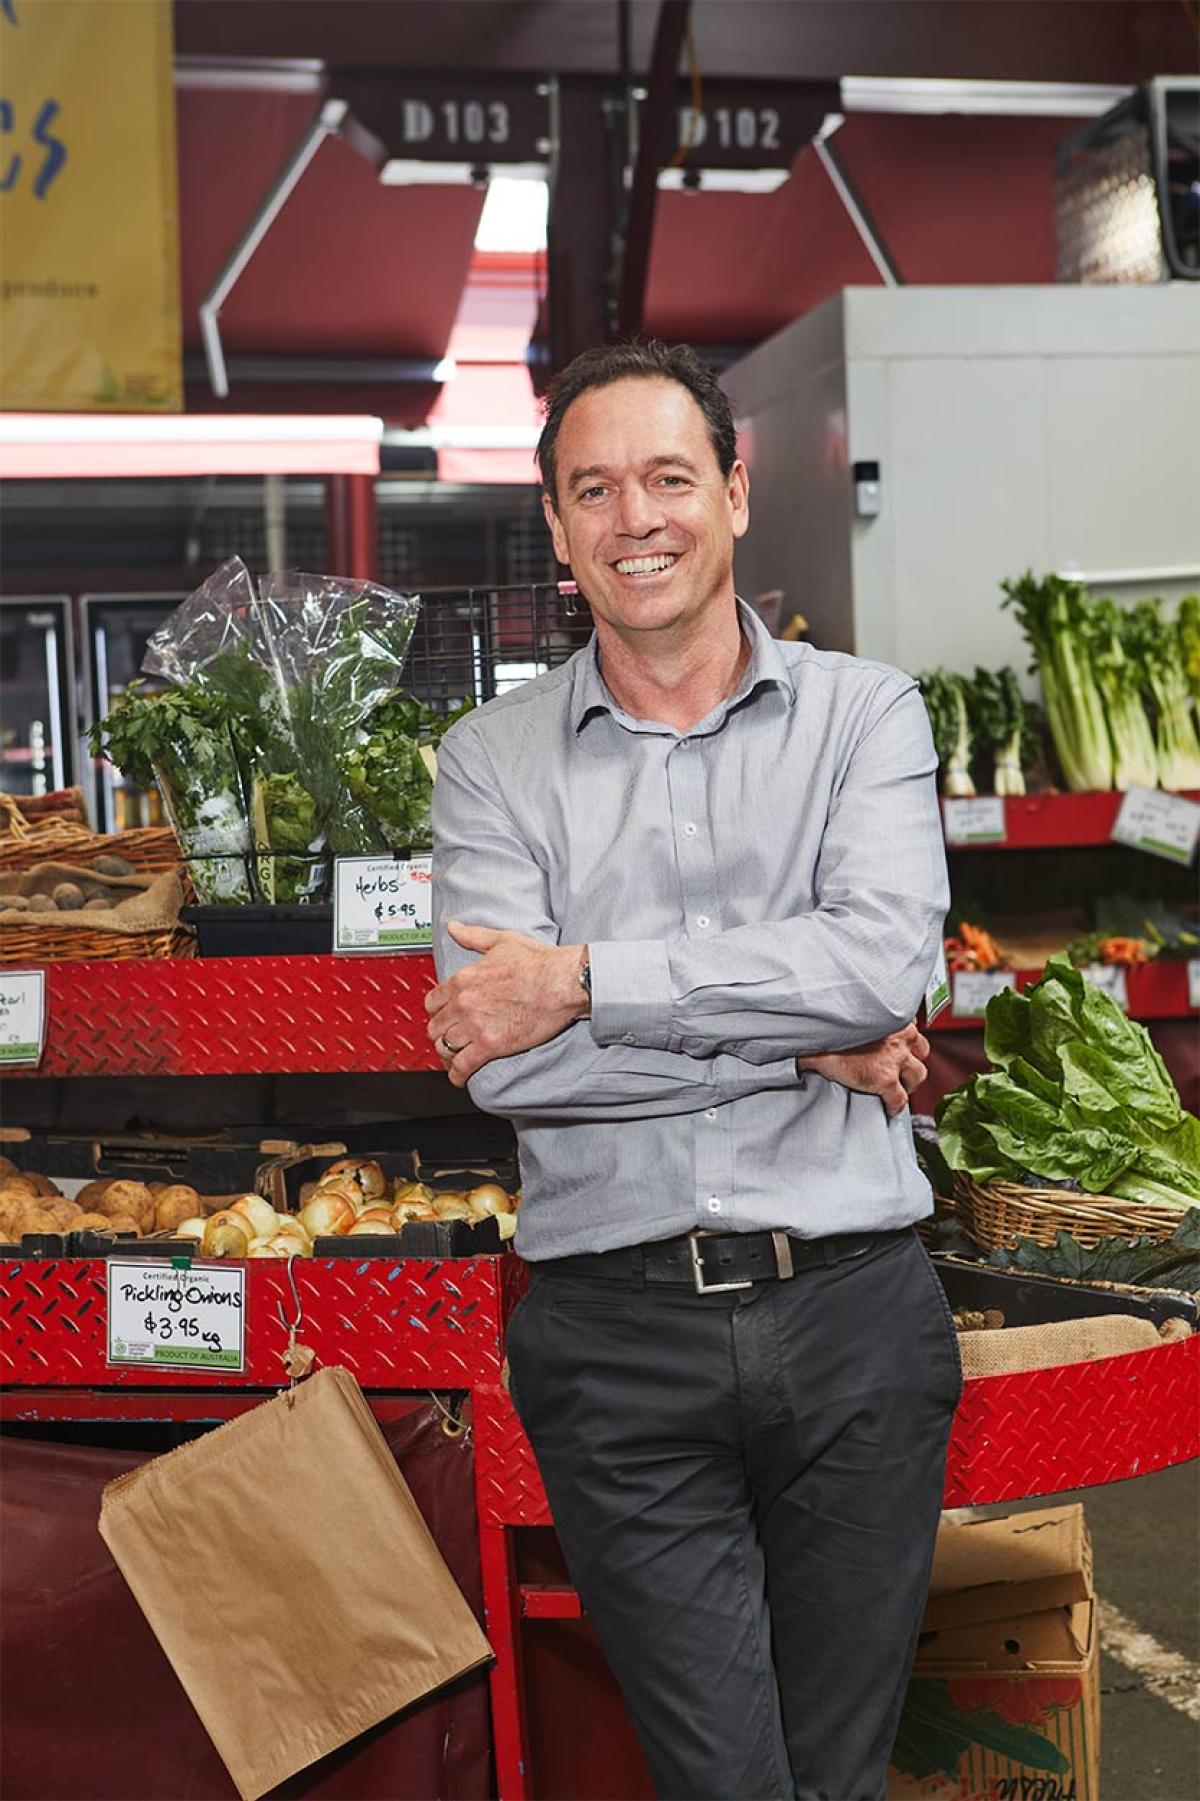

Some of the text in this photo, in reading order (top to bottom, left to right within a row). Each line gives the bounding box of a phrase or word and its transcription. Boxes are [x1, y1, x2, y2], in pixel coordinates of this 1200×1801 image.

[402, 100, 509, 142] D 103
[678, 106, 780, 149] D 102
[356, 876, 399, 901] Herbs
[143, 1272, 210, 1283] Certified Organic
[120, 1284, 242, 1312] Pickling Onions
[155, 1350, 239, 1363] PRODUCT OF AUSTRALIA
